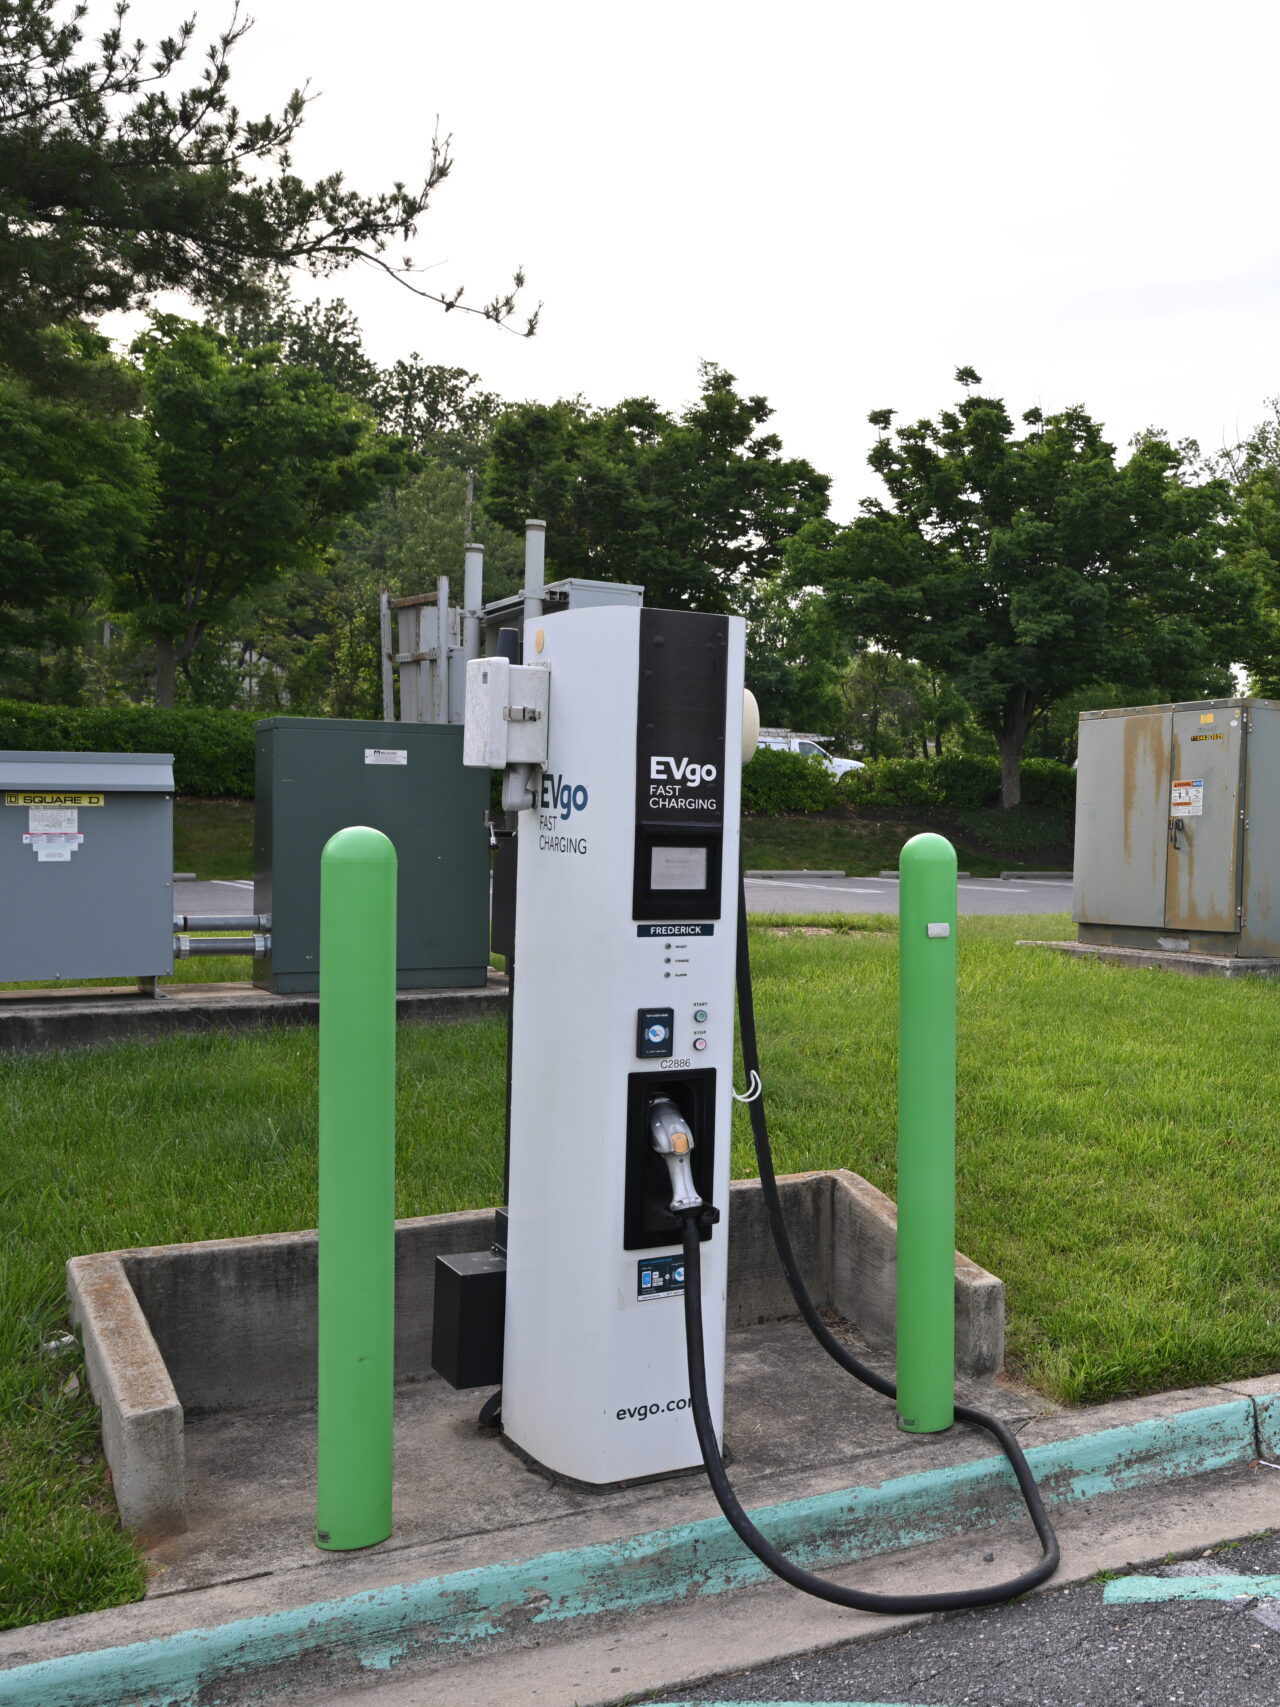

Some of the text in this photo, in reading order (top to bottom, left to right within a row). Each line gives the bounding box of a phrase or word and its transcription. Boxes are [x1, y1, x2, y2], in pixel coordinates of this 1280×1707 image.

[650, 756, 717, 787] EVgo
[540, 774, 588, 820] EVgo
[650, 785, 682, 797] FAST
[23, 796, 82, 804] SQUARE
[88, 796, 99, 804] D
[649, 798, 717, 810] CHARGING
[539, 815, 557, 831] FAST
[539, 835, 587, 854] CHARGING
[650, 926, 702, 935] FREDERICK
[660, 1059, 691, 1069] C2886
